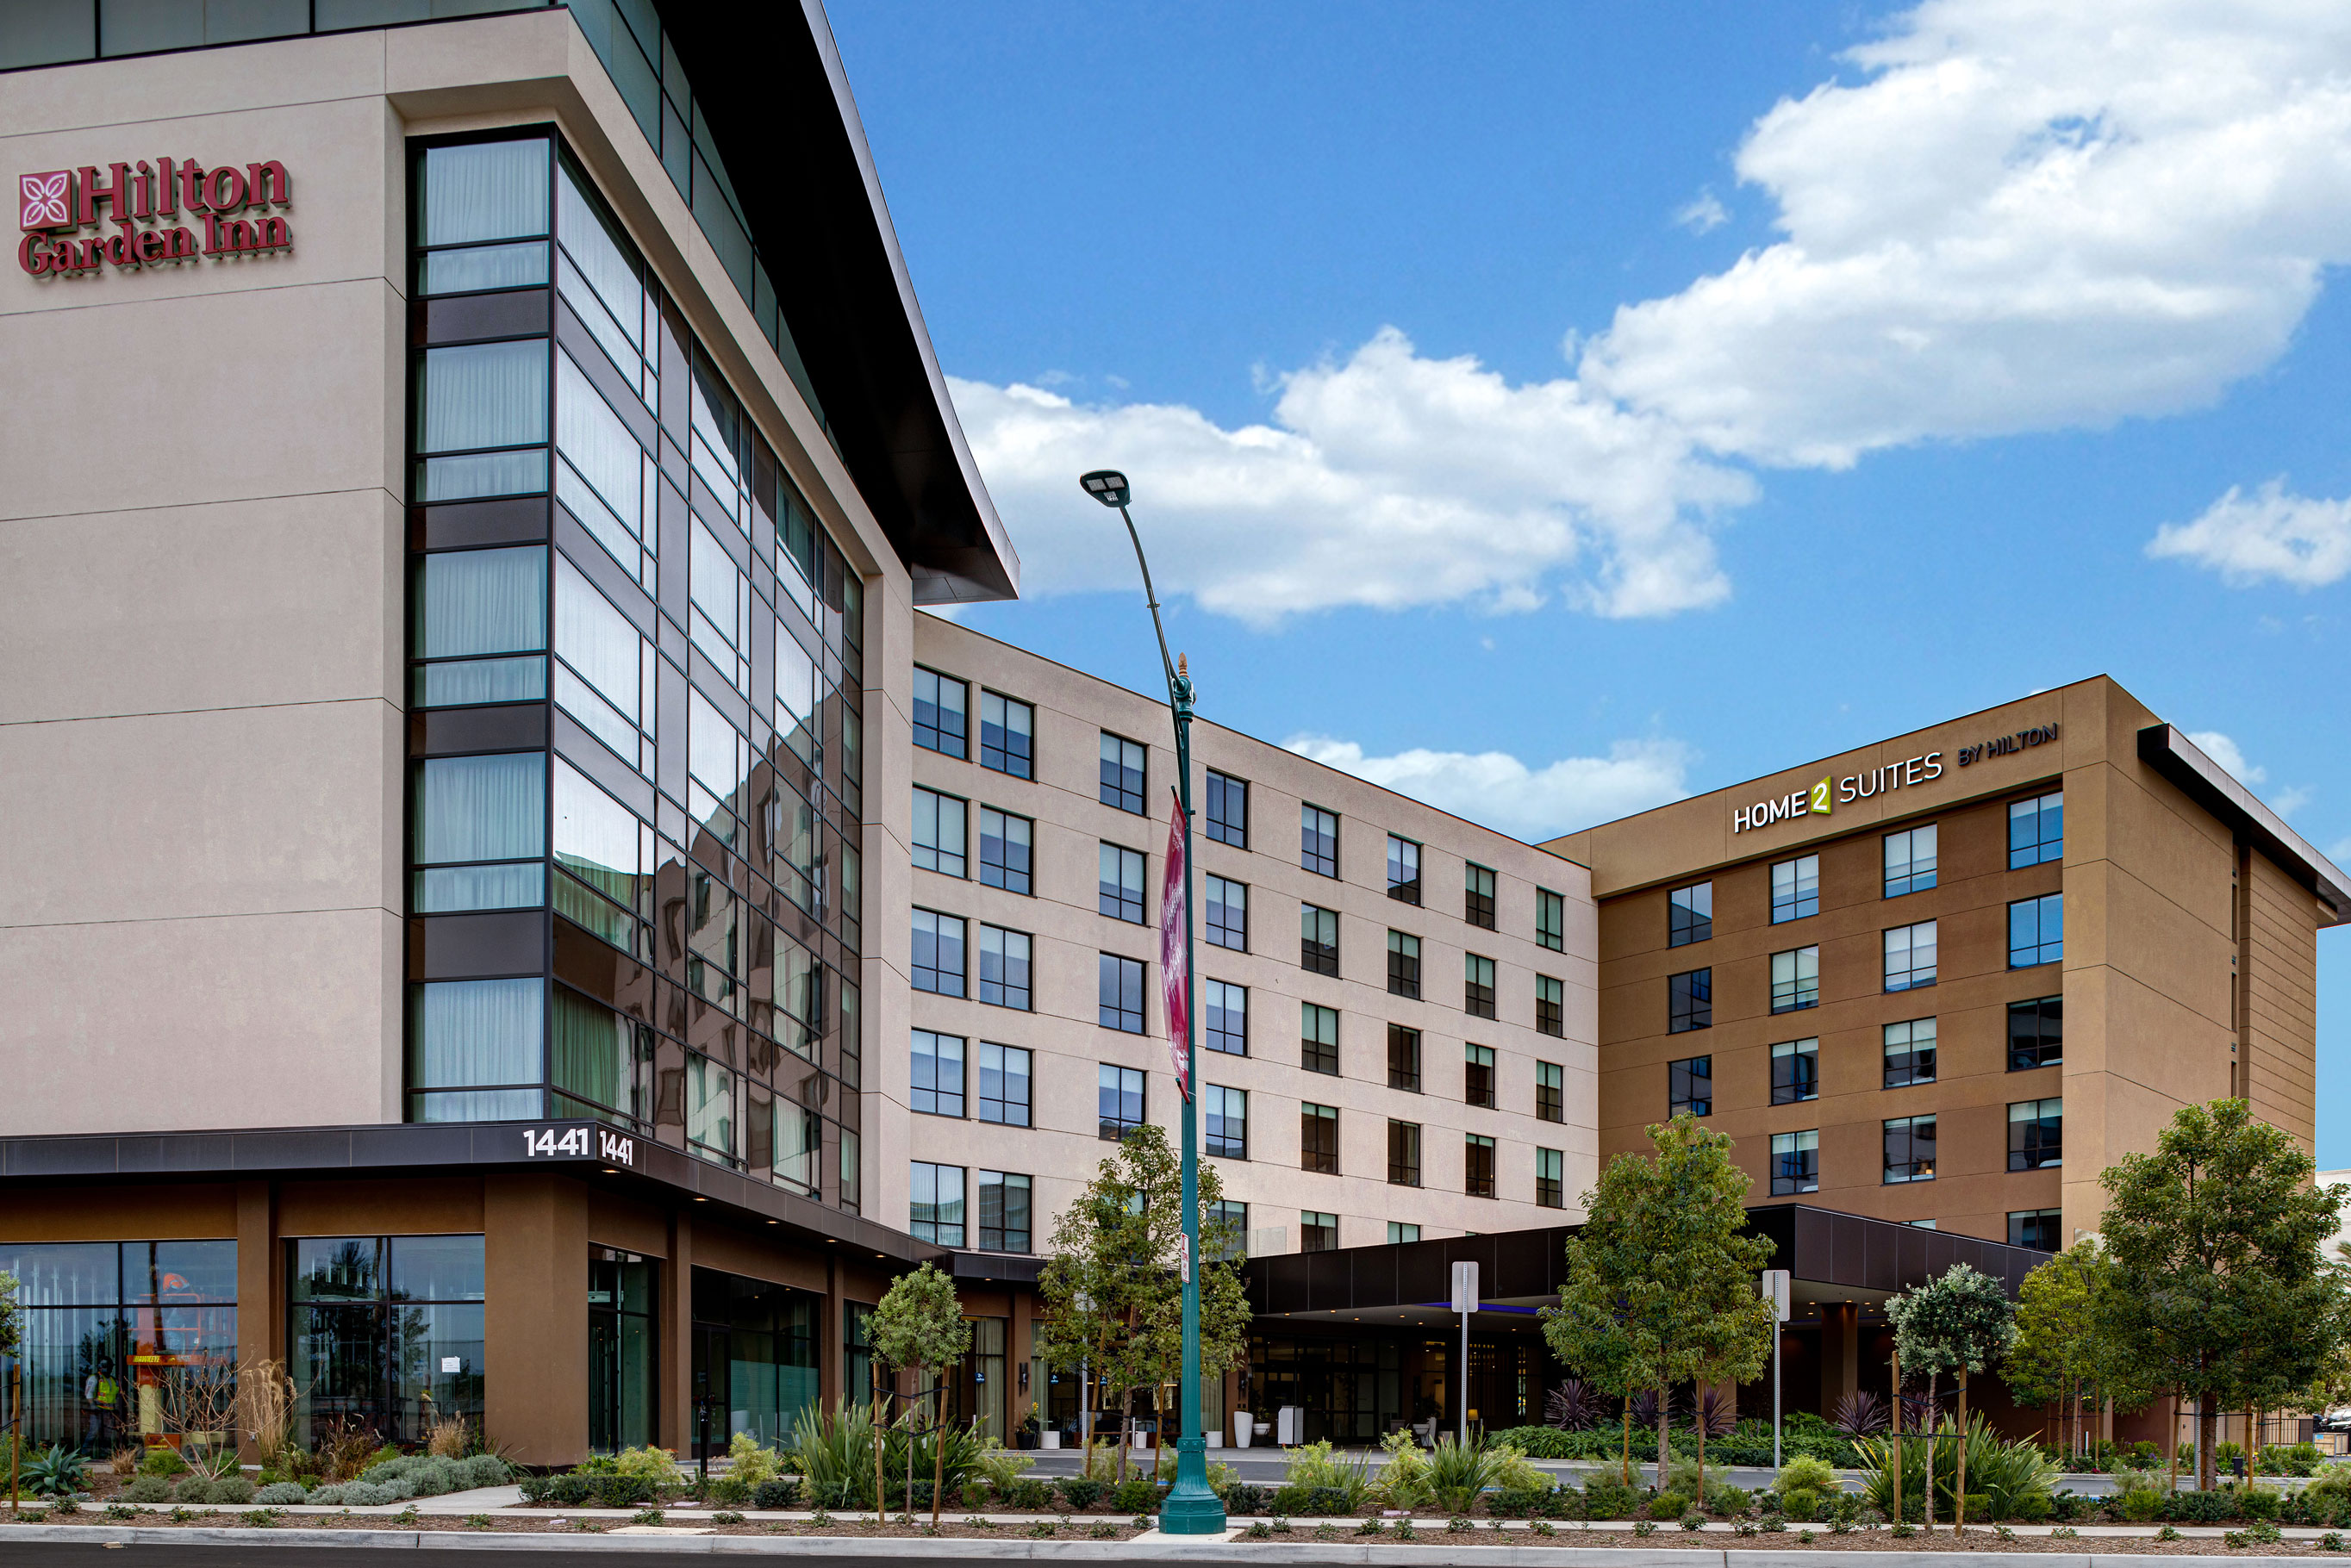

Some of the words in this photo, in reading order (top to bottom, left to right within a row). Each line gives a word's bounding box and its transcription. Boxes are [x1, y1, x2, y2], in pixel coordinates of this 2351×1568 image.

[78, 156, 290, 227] Hilton
[18, 223, 197, 276] Garden
[202, 213, 291, 258] Inn
[1734, 789, 1807, 833] HOME
[1812, 782, 1828, 811] 2
[1840, 751, 1943, 803] SUITES
[1957, 744, 1982, 767] BY
[1986, 723, 2057, 758] HILTON
[523, 1128, 589, 1156] 1441
[600, 1130, 633, 1166] 1441
